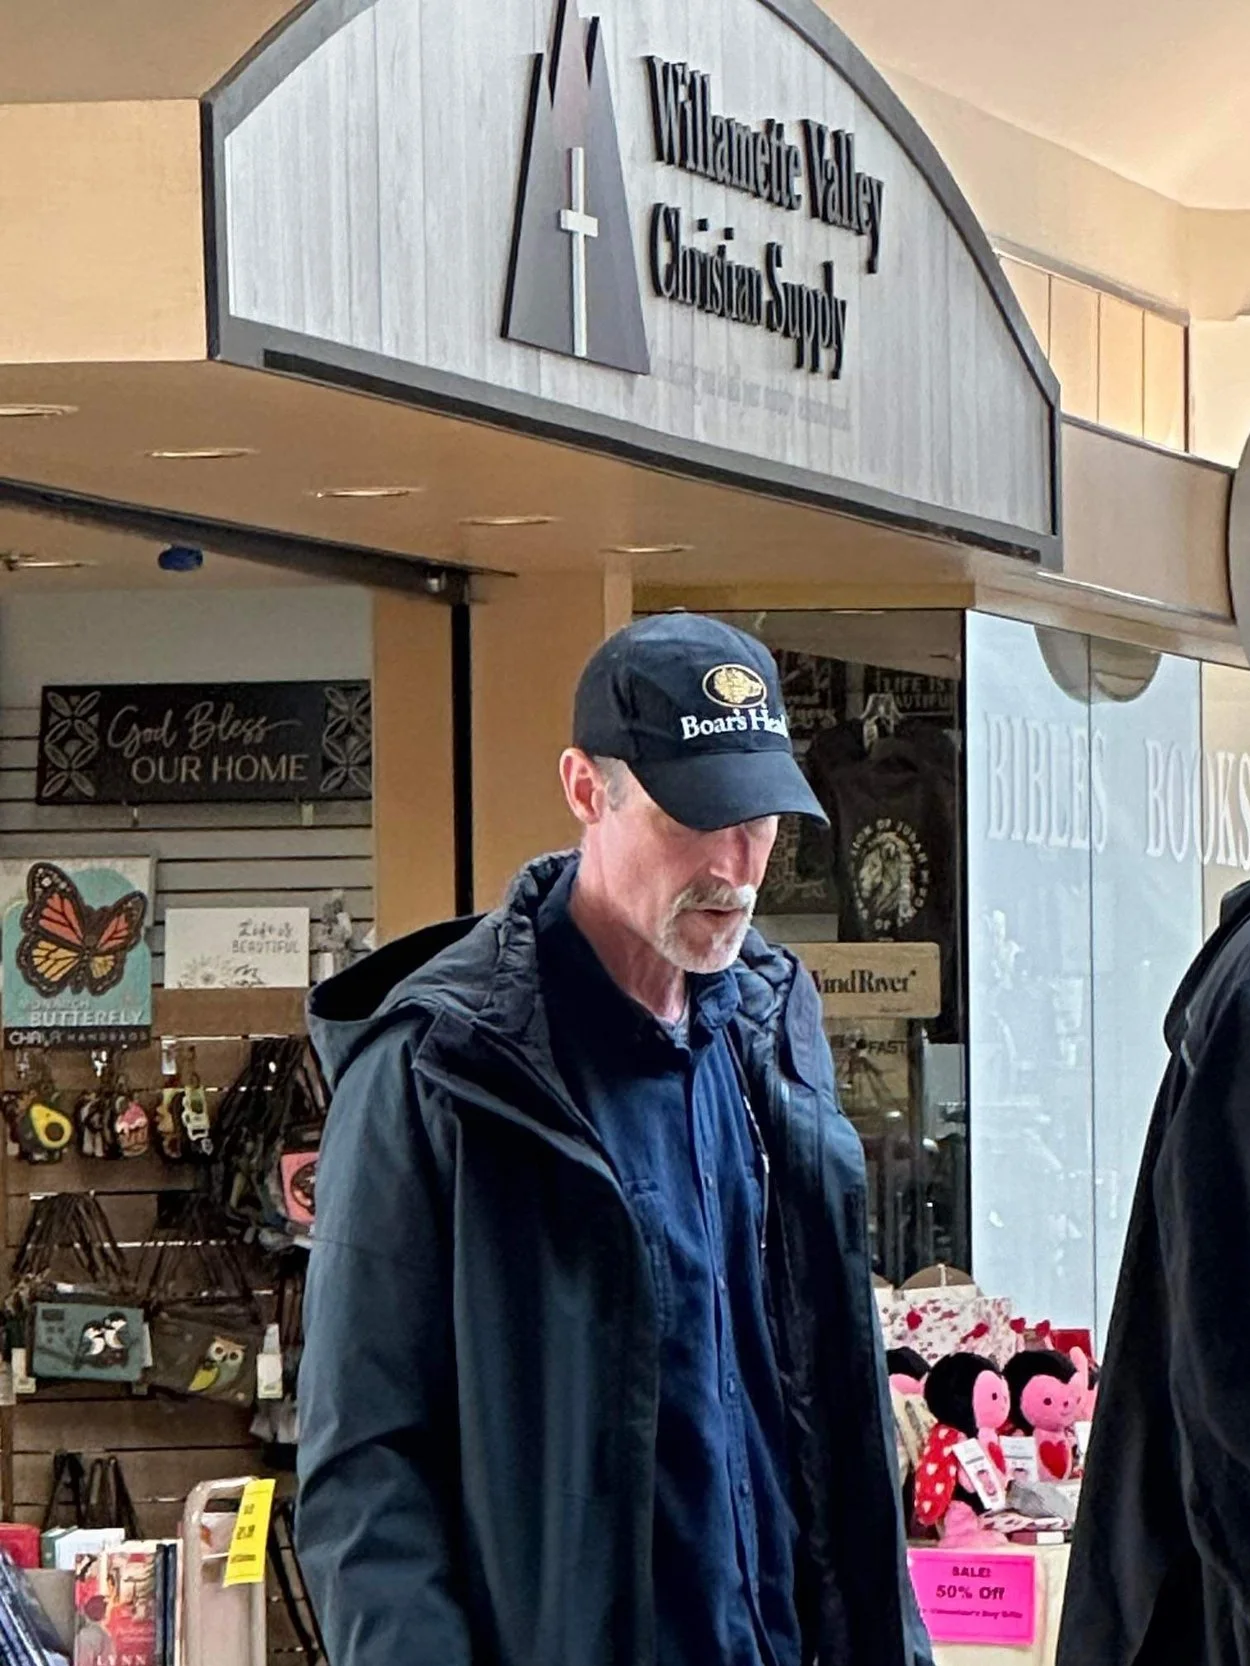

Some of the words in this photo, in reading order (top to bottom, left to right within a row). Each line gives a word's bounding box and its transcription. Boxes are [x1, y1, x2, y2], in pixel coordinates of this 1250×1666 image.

[646, 55, 802, 211] Willamette
[800, 118, 884, 274] Valley
[650, 202, 763, 327] Christian
[766, 242, 847, 380] Supply
[107, 705, 178, 758] God
[185, 701, 302, 751] Bless
[680, 707, 748, 740] Boar's
[132, 755, 201, 784] OUR
[212, 754, 309, 783] HOME
[985, 712, 1107, 854] BIBLES
[30, 1009, 142, 1027] BUTTERFLY
[935, 1584, 973, 1599] 50%
[97, 1655, 147, 1666] LYNN
